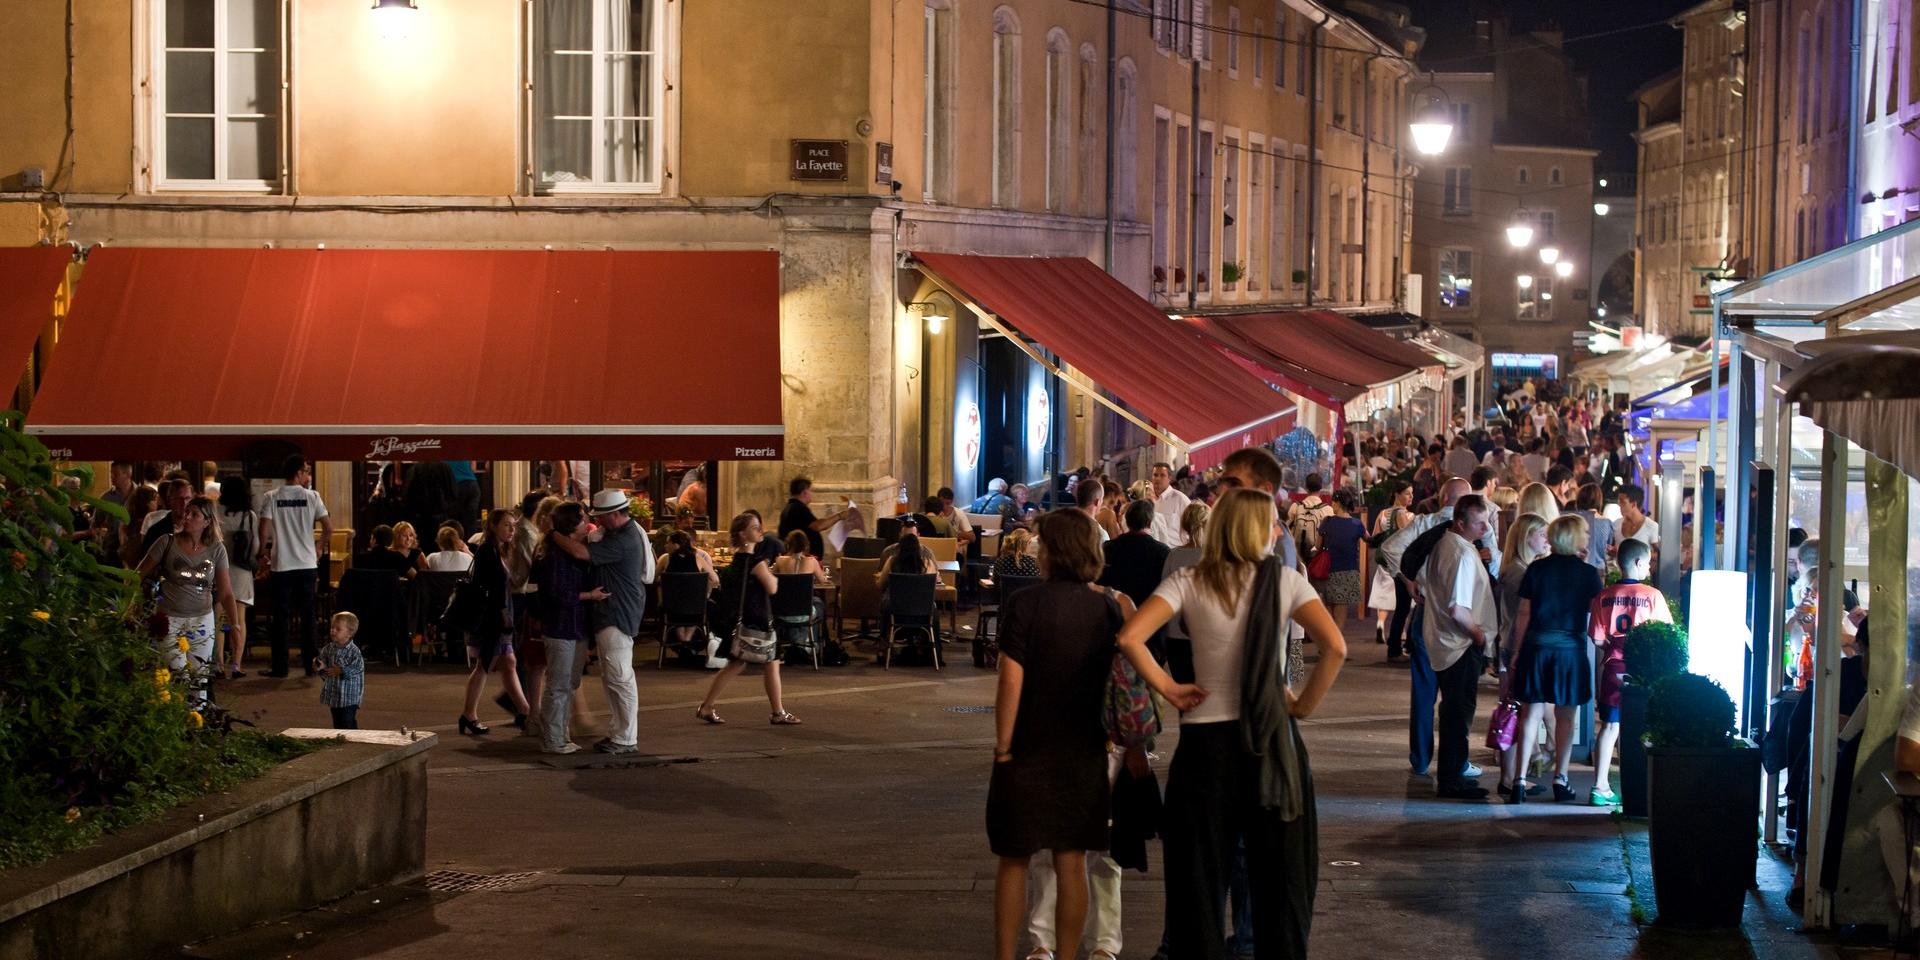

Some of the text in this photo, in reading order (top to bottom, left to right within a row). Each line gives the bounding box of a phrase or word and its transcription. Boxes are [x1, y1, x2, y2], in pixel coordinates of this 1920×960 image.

[809, 149, 829, 157] PLACE
[796, 160, 843, 173] La Fayette
[382, 436, 442, 456] Piazzetta
[735, 447, 776, 457] Pizzeria
